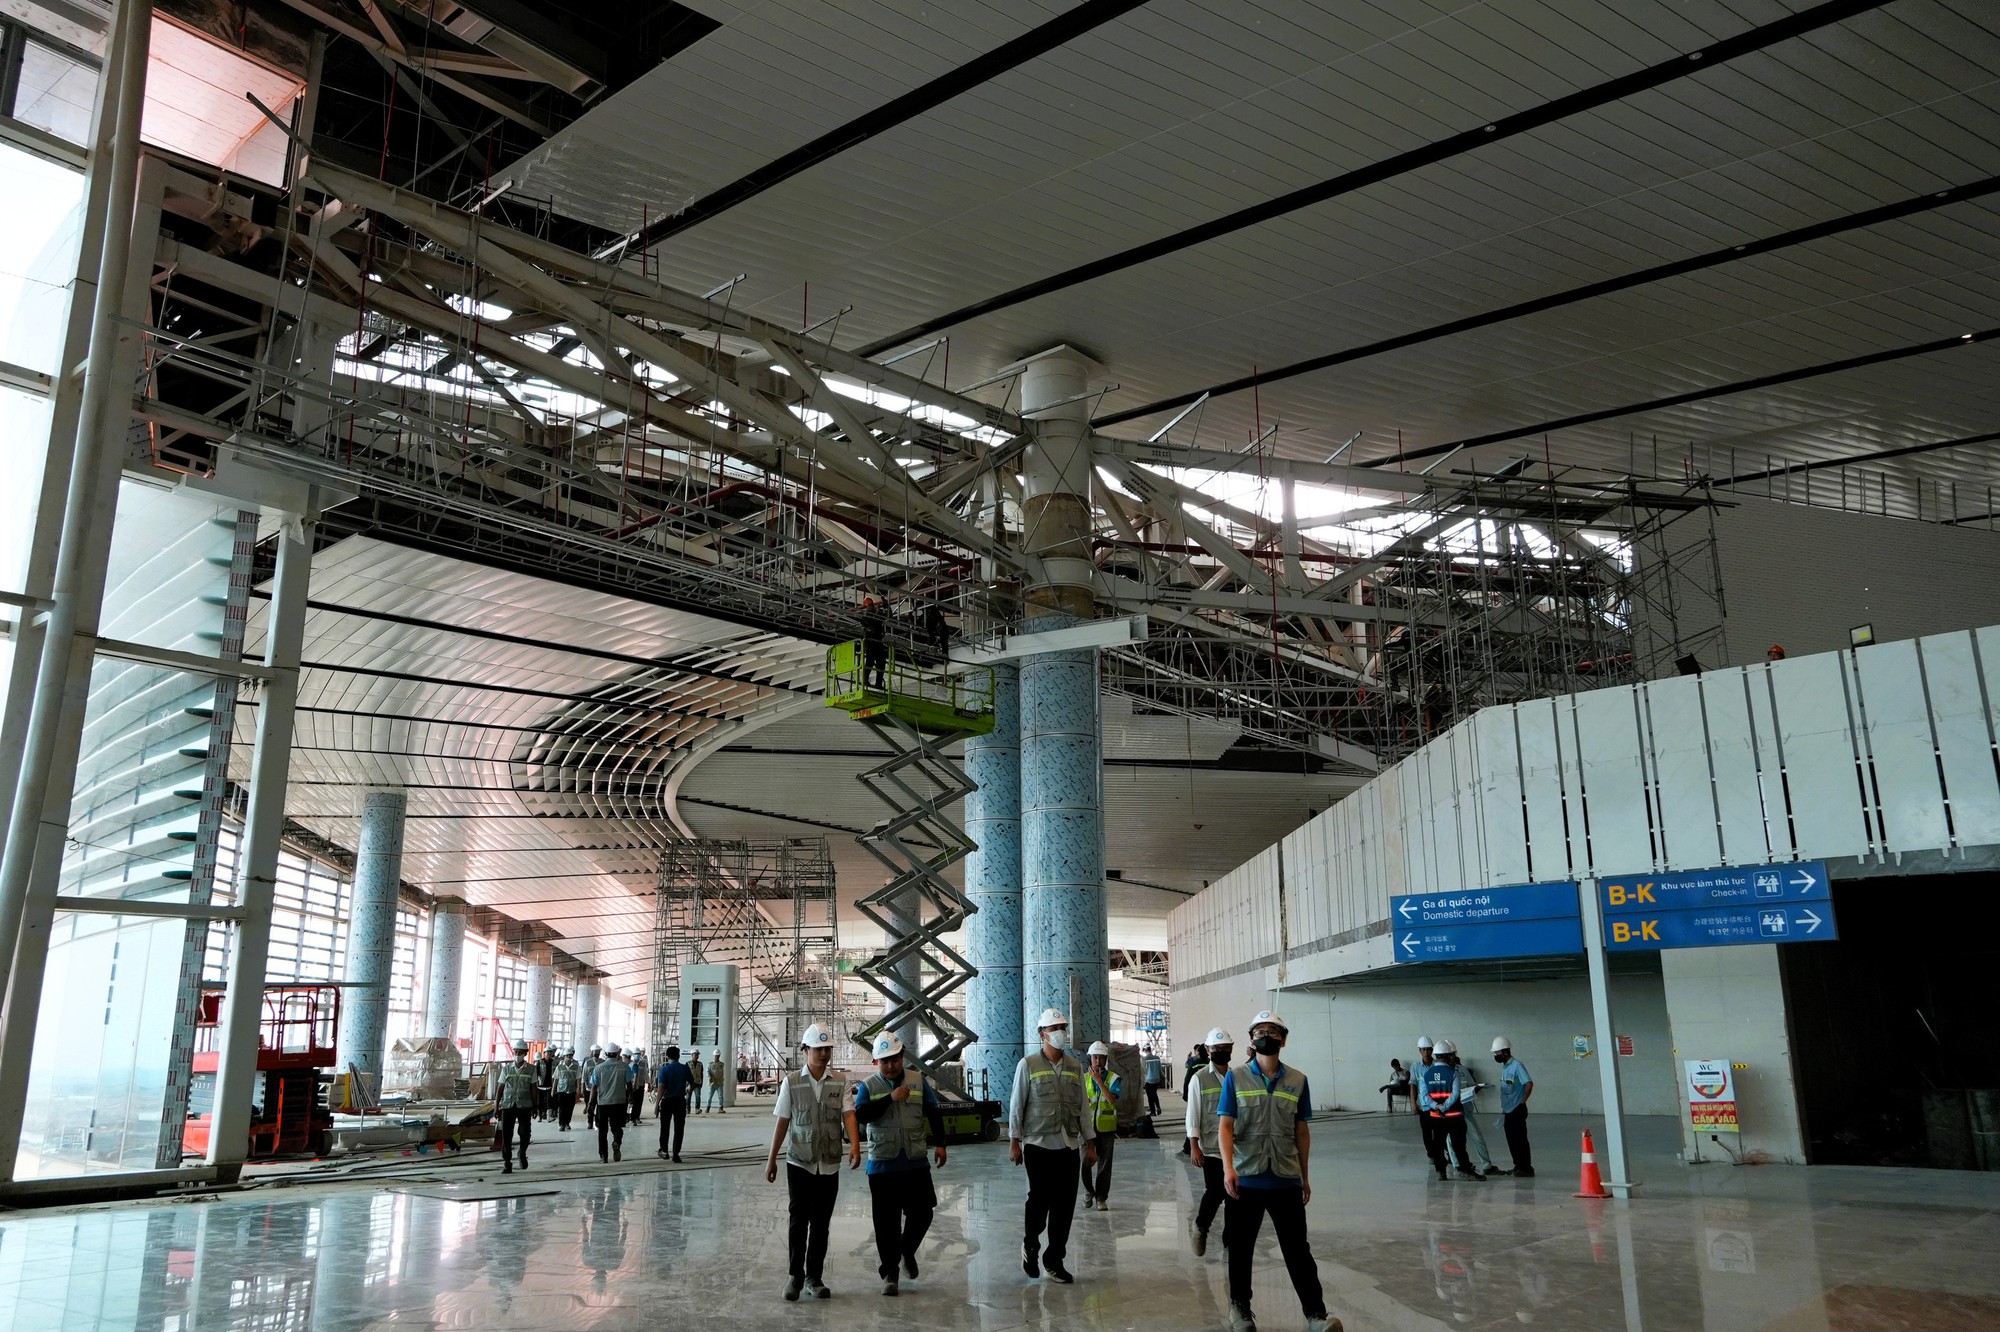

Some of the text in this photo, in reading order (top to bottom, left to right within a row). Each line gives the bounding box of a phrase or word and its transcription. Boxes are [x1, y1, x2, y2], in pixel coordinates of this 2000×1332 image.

[1661, 877, 1746, 890] Khu vực làm thủ tục
[1608, 882, 1656, 906] B-K
[1711, 888, 1748, 898] Check-in
[1422, 895, 1490, 909] Ga đi quốc nội
[1423, 907, 1510, 921] Domestic departure
[1612, 919, 1661, 943] B-K
[1693, 1113, 1736, 1124] CẤM VÀO
